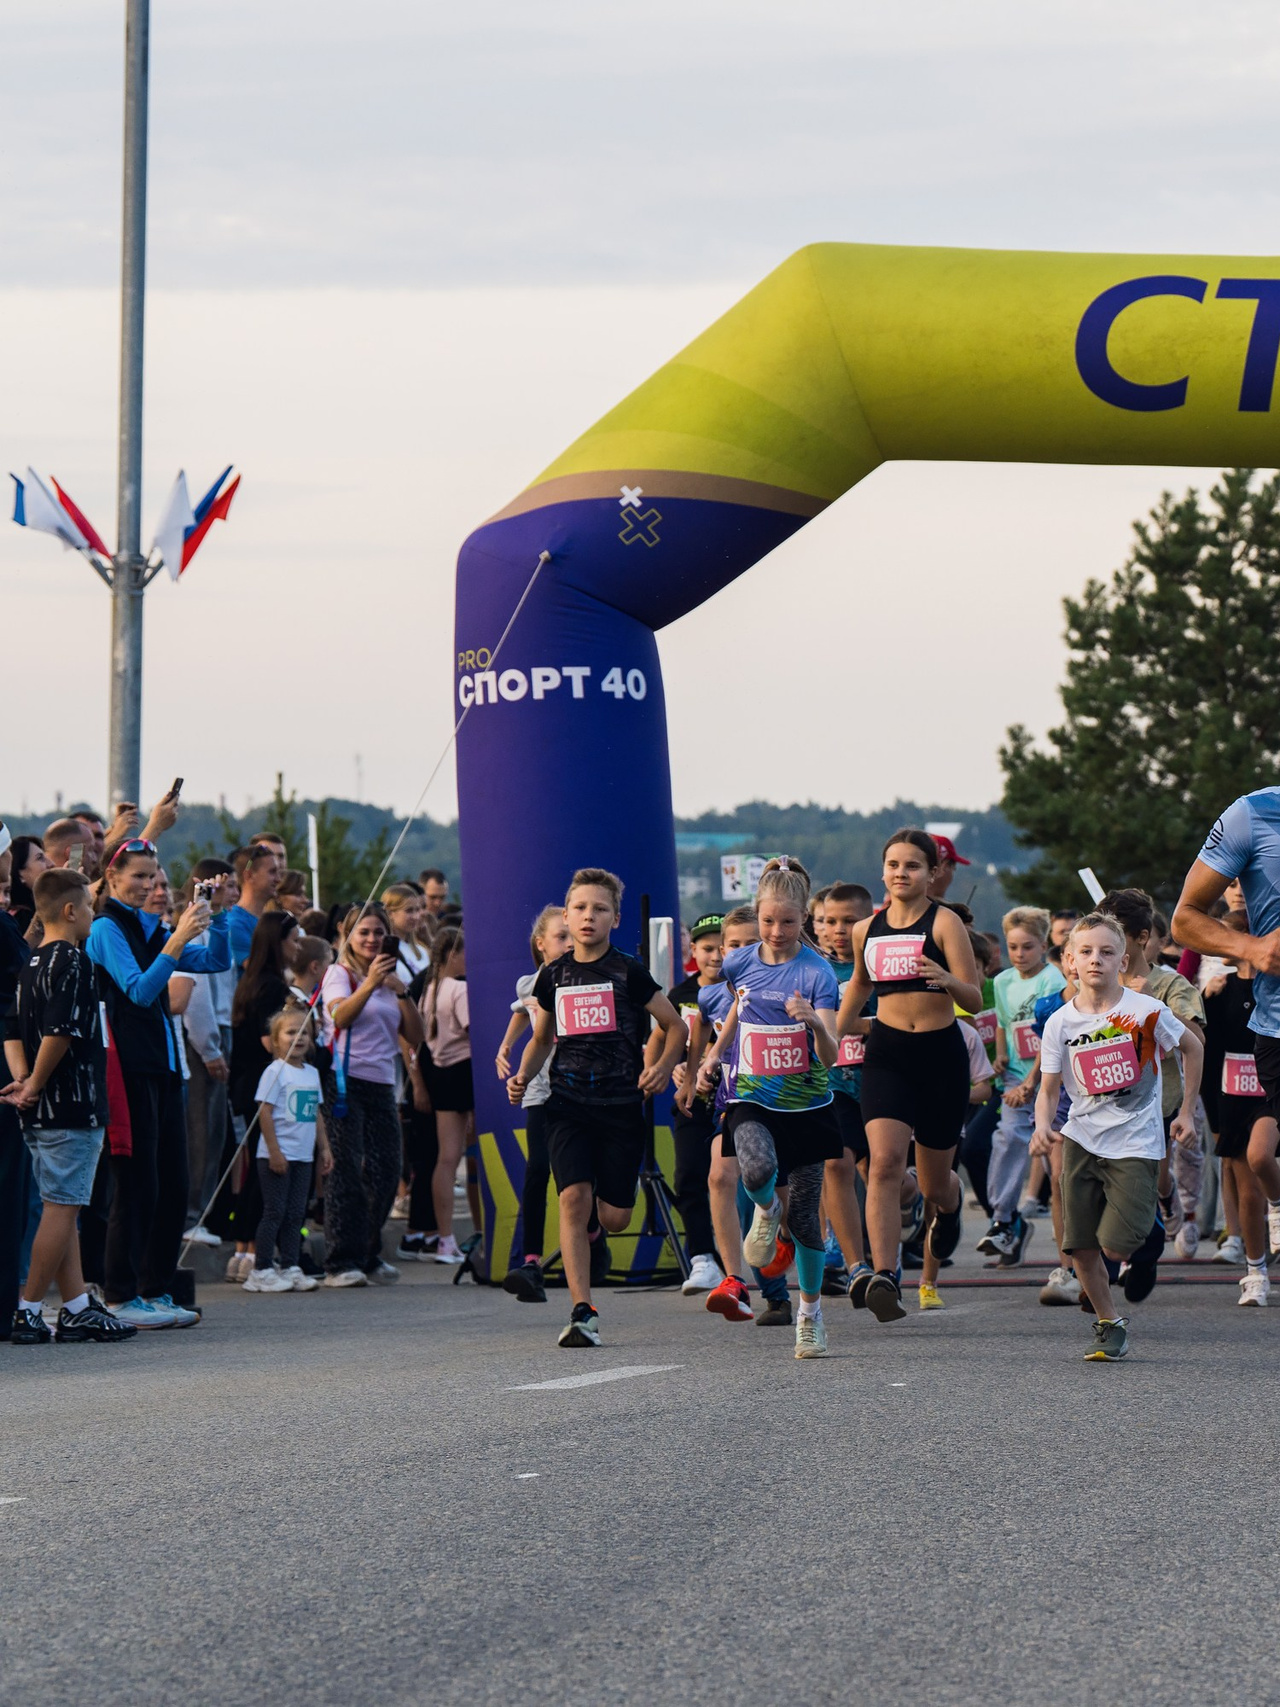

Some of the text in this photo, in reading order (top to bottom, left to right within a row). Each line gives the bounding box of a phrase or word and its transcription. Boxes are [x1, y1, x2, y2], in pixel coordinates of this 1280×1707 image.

[458, 647, 491, 672] PRO
[459, 666, 647, 708] СПОРТ 40
[882, 956, 918, 977] 2035
[574, 994, 602, 1006] ЕВГЕНИЙ
[573, 1006, 610, 1028] 1529
[766, 1037, 792, 1046] МАРИЯ
[762, 1047, 803, 1069] 1632
[1094, 1051, 1123, 1065] НИКИТА
[1091, 1060, 1135, 1089] 3385
[1234, 1074, 1265, 1093] 188
